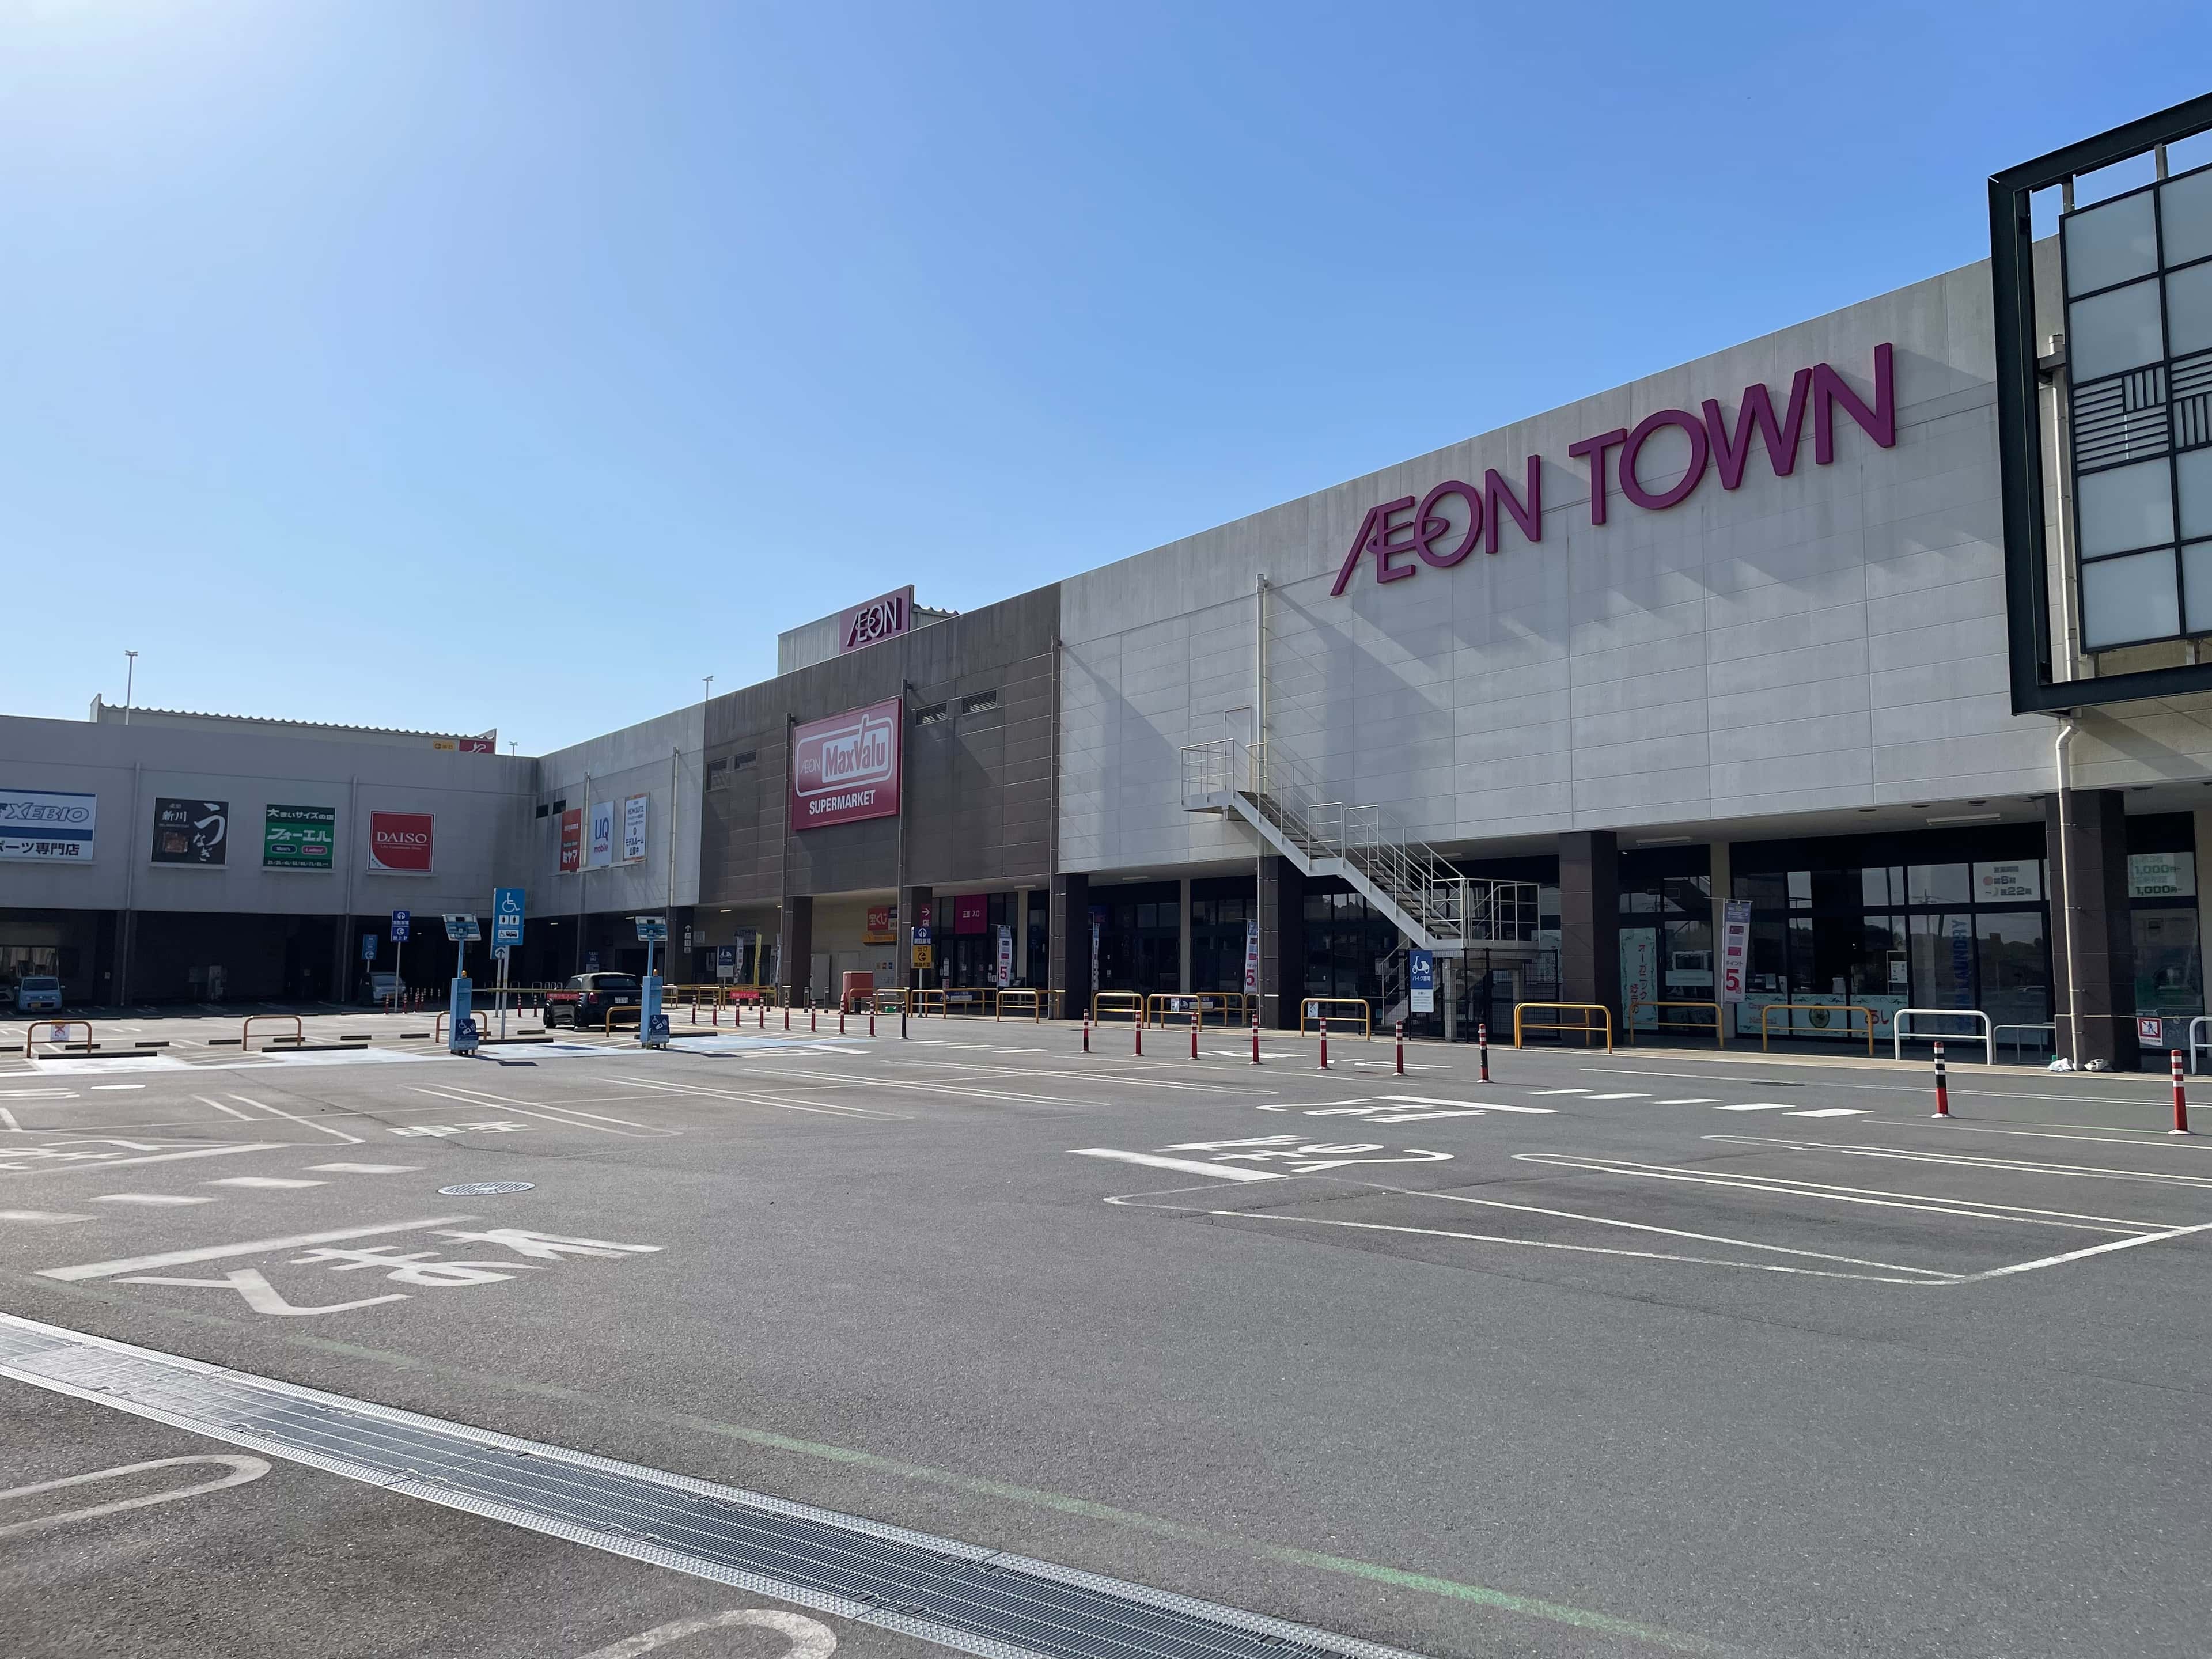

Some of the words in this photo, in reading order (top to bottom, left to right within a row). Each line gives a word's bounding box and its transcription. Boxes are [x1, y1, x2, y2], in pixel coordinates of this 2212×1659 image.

[1568, 342, 1896, 526] TOWN
[825, 717, 886, 778] MaxValu
[5, 802, 89, 823] XEBIO
[809, 789, 876, 815] SUPERMARKET
[162, 810, 187, 822] 新川
[193, 802, 226, 862] うなぎ
[267, 828, 332, 842] フォーエル
[377, 831, 427, 844] DAISO
[595, 817, 609, 842] UQ
[594, 843, 609, 853] mobile
[109, 1228, 664, 1316] とまれ
